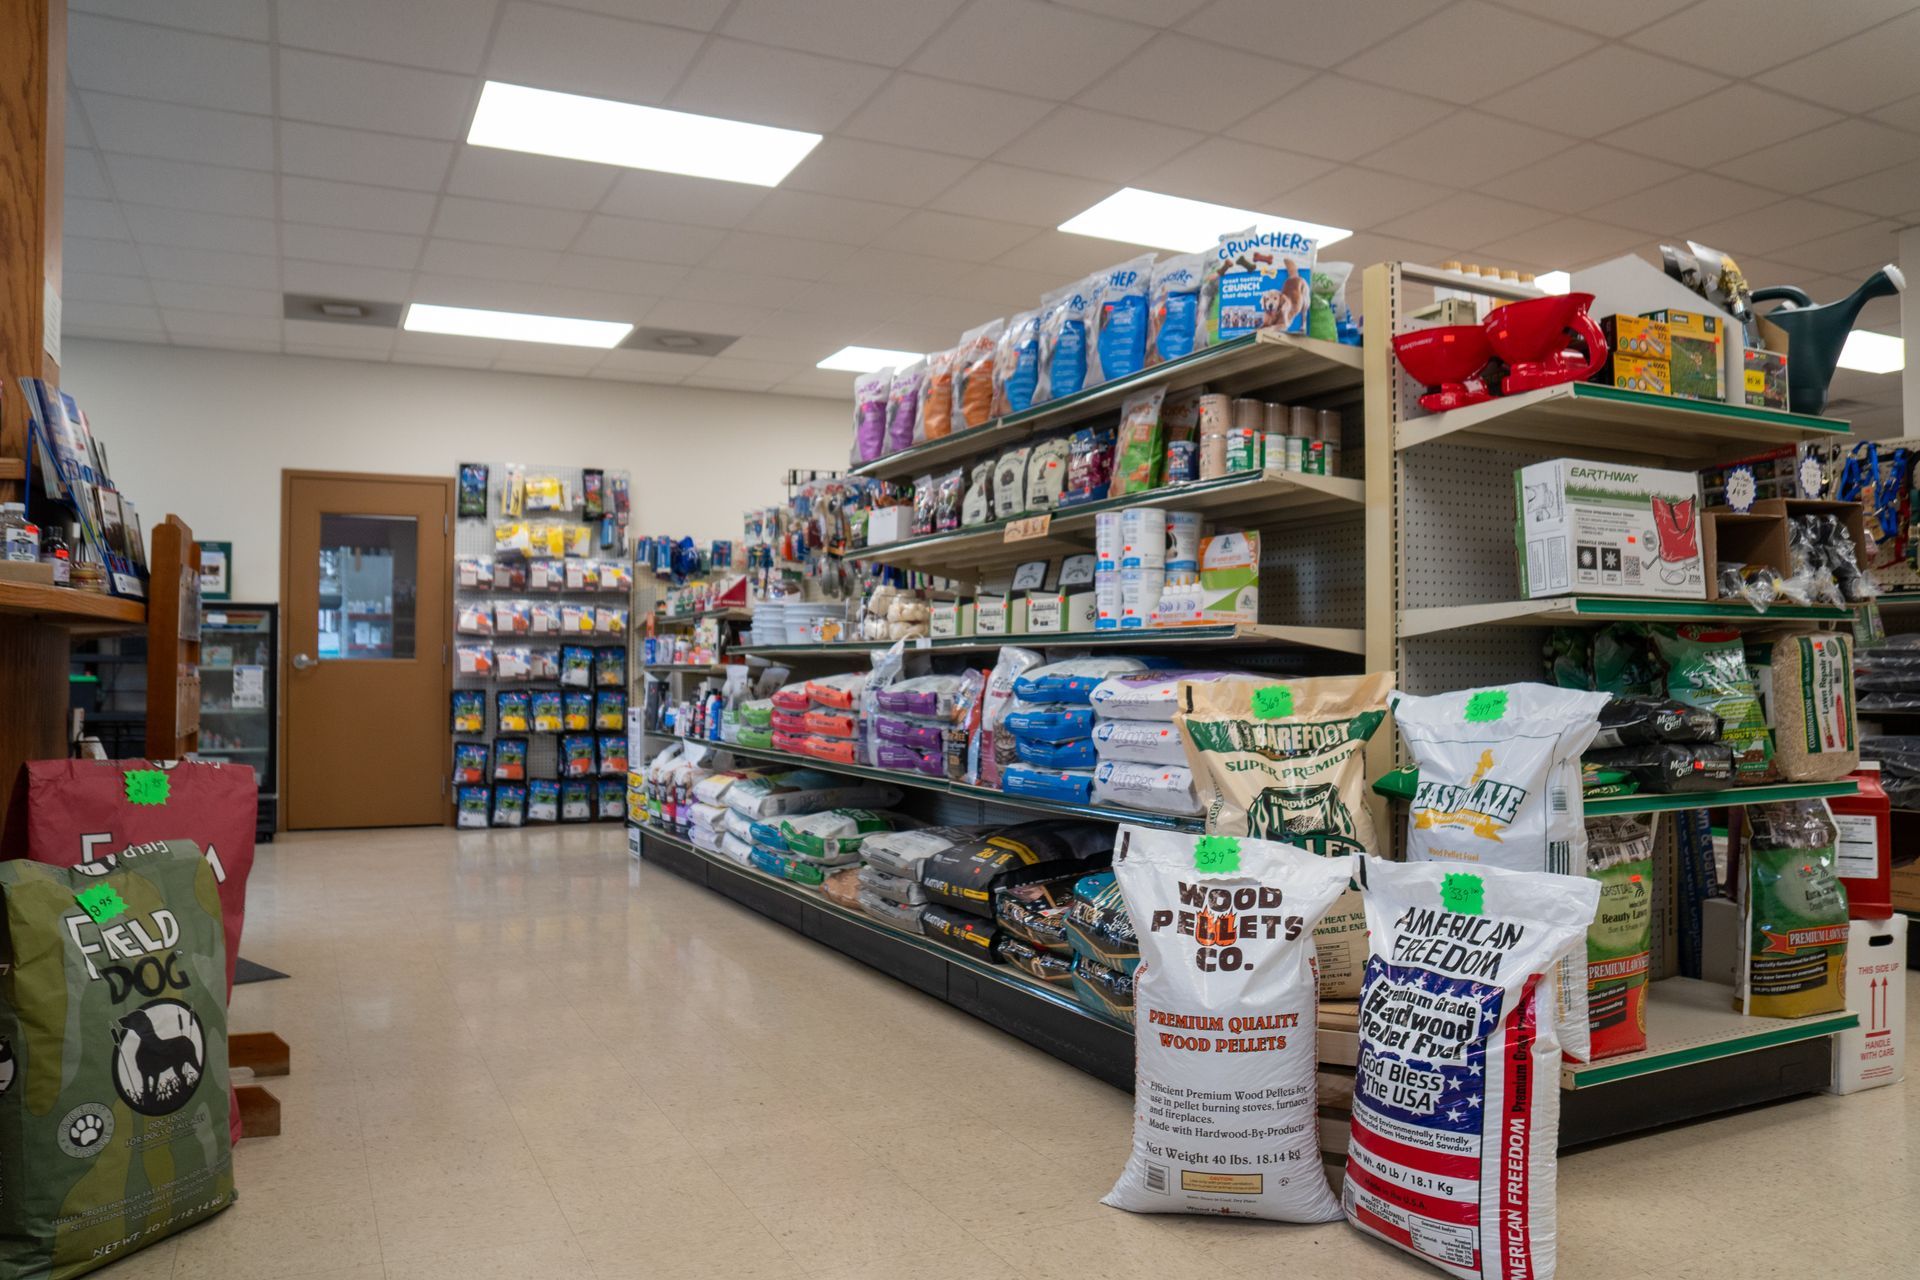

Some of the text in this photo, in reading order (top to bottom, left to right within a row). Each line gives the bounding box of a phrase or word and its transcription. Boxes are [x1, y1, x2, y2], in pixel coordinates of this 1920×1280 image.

[1219, 231, 1312, 260] CRUNCHERS
[1222, 283, 1260, 292] CRUNCH
[1570, 466, 1639, 483] EARTHWAY
[1805, 697, 1816, 749] COMBINATION
[1225, 760, 1281, 781] SUPER
[1269, 790, 1329, 821] HARDWOOD
[123, 840, 170, 858] FIELD
[1200, 851, 1225, 864] 329
[1178, 881, 1283, 912] WOOD
[1151, 909, 1304, 942] PELLETS
[1312, 925, 1347, 936] EWABLE
[1324, 914, 1347, 924] HEAT
[1394, 906, 1525, 951] AMERICAN
[1602, 911, 1630, 924] Beauty
[65, 908, 180, 981] FIELD
[1790, 930, 1825, 945] PREMIUM
[1196, 946, 1254, 973] CO.
[1392, 934, 1503, 981] FREEDOM
[1589, 960, 1626, 979] PREMIUM
[1858, 962, 1900, 975] THIS SIDE UP
[100, 951, 191, 1004] DOG
[1376, 980, 1476, 1019] Premium Grade
[1149, 1008, 1300, 1035] PREMIUM QUALITY
[1365, 989, 1474, 1042] Hadwood
[1159, 1032, 1287, 1053] WOOD PELLETS
[1412, 1033, 1466, 1060] Fuel
[1860, 1047, 1895, 1061] WITH CARE
[1865, 1038, 1891, 1050] HANDLE
[1362, 1050, 1442, 1091] God Bless
[1186, 1088, 1232, 1100] Premium
[1234, 1089, 1264, 1101] Wood
[1266, 1087, 1295, 1099] Pellets
[1295, 1085, 1308, 1095] for
[1364, 1076, 1388, 1098] The
[1393, 1087, 1432, 1111] USA
[1511, 1064, 1527, 1113] Premium
[1149, 1104, 1215, 1124] and fireplaces.
[1150, 1094, 1162, 1104] use
[1163, 1096, 1172, 1106] in
[1173, 1098, 1200, 1112] pellet
[1202, 1102, 1240, 1114] burning
[1276, 1097, 1308, 1110] furnaces
[1148, 1117, 1305, 1140] Made with Hardwood-By-Products
[1379, 1118, 1433, 1138] Environmentally
[1436, 1133, 1469, 1146] Friendly
[1379, 1125, 1394, 1137] from
[1395, 1132, 1434, 1147] Hardwood
[1436, 1141, 1473, 1153] Sawdust
[1145, 1140, 1302, 1165] Net Weight 40 lbs. 18.14 kg
[1508, 1118, 1526, 1205] FREEDOM
[1375, 1162, 1387, 1174] 40
[1389, 1167, 1400, 1181] Lb
[1410, 1175, 1433, 1189] 18.1
[1437, 1181, 1454, 1196] Kg
[93, 1241, 120, 1258] NET
[1507, 1210, 1528, 1280] MERICAN
